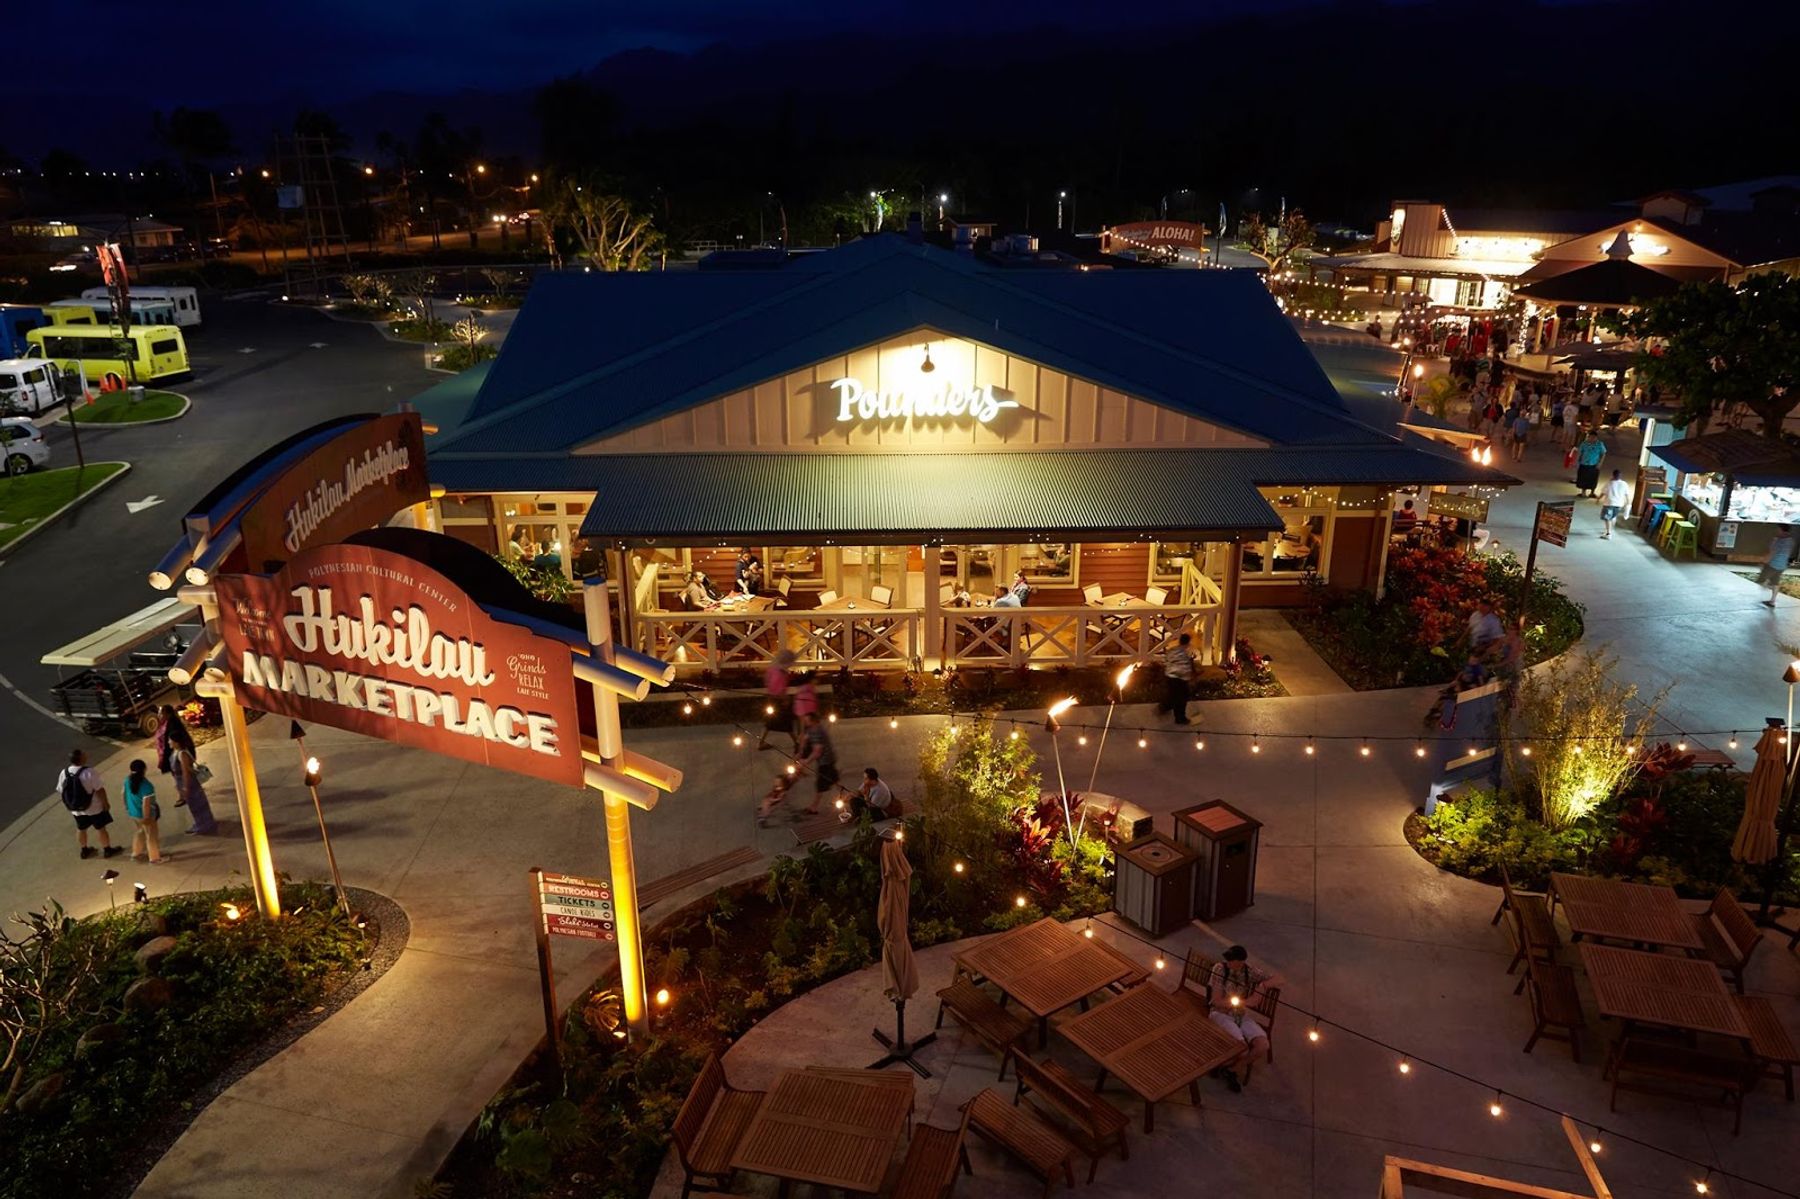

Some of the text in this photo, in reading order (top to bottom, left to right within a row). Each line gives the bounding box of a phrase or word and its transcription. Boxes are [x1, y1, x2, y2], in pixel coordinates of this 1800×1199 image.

[1151, 226, 1195, 241] ALOHA!
[830, 376, 1020, 423] Pounders
[285, 440, 410, 553] Hukilau Marketplace
[308, 562, 457, 613] POLYNESIAN CULTURAL CENTER
[282, 584, 495, 687] Hukilau
[506, 655, 547, 680] Grinds
[518, 673, 544, 690] RELAX
[242, 649, 562, 757] MARKETPLACE
[531, 690, 549, 700] STYLE
[548, 884, 600, 898] RESTROOMS
[558, 896, 596, 907] TICKETS
